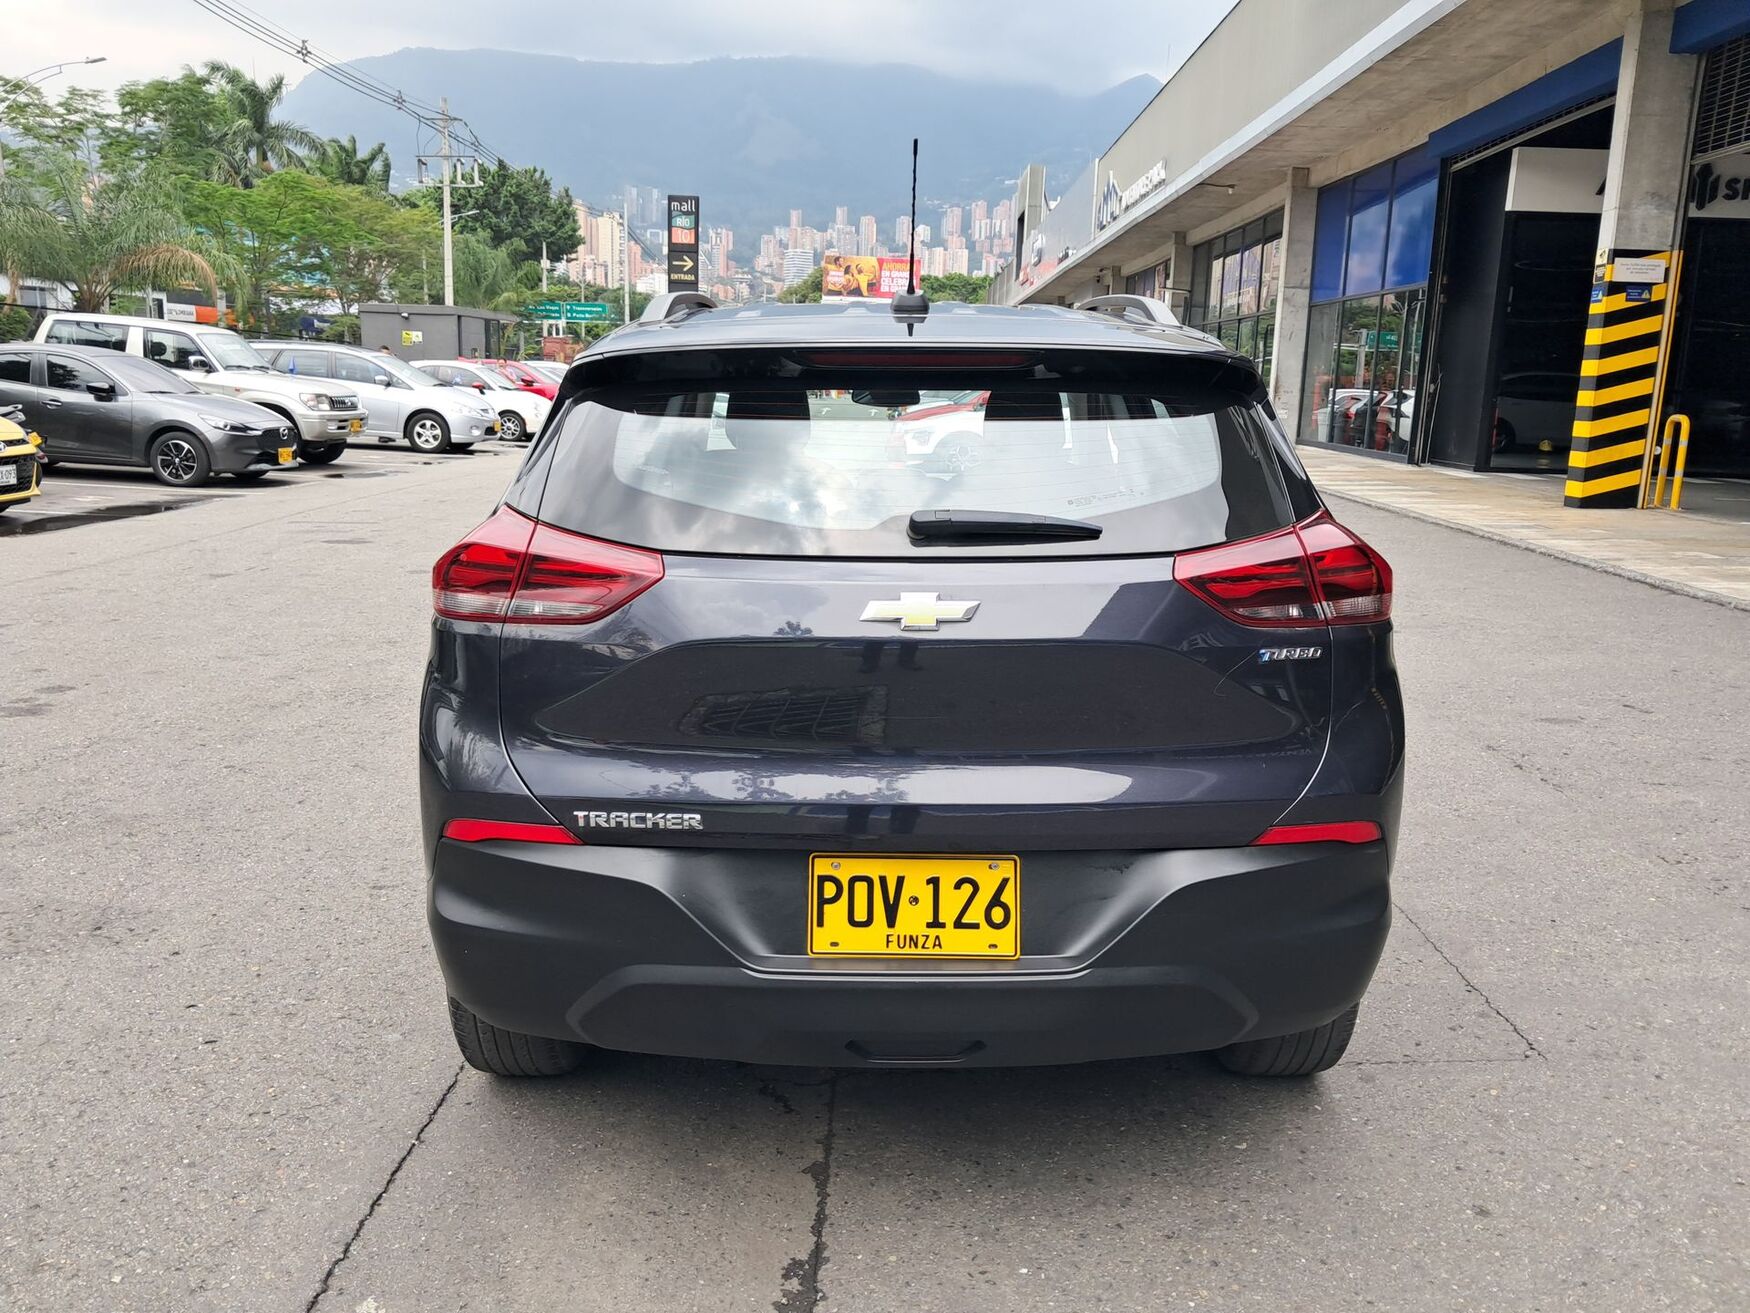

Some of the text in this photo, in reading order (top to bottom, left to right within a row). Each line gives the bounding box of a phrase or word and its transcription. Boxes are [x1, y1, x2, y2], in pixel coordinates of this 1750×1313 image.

[671, 200, 695, 211] mall
[1259, 647, 1323, 662] TURBO
[573, 811, 703, 830] TRACKER
[886, 934, 943, 950] FUNZA
